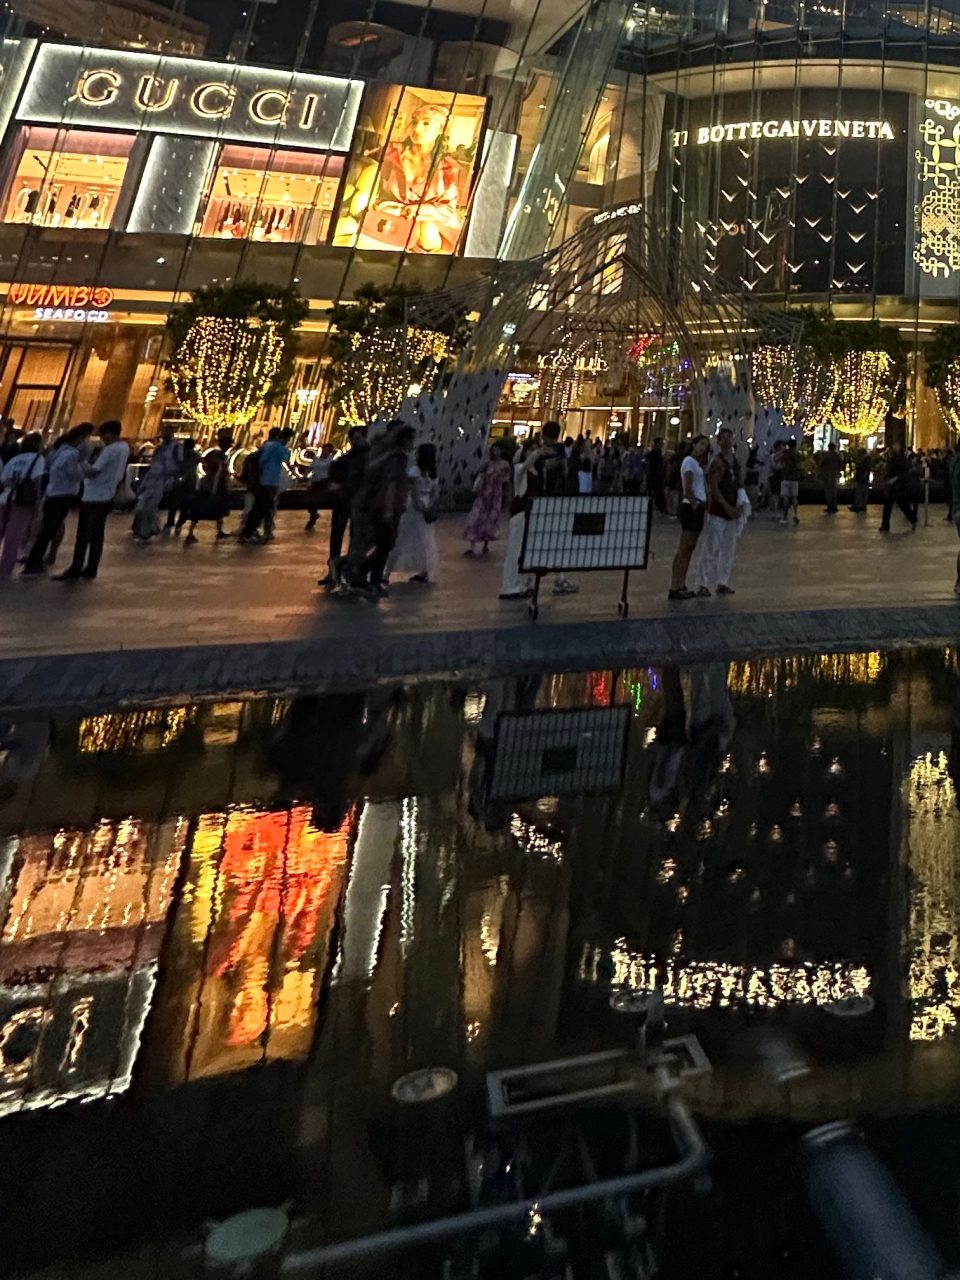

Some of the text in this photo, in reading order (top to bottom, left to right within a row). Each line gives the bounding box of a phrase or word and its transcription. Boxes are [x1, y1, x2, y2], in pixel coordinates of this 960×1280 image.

[76, 69, 319, 129] GUCCI
[801, 120, 895, 140] VENETA
[8, 283, 114, 307] JUMBO
[34, 307, 109, 321] SEAFOOD
